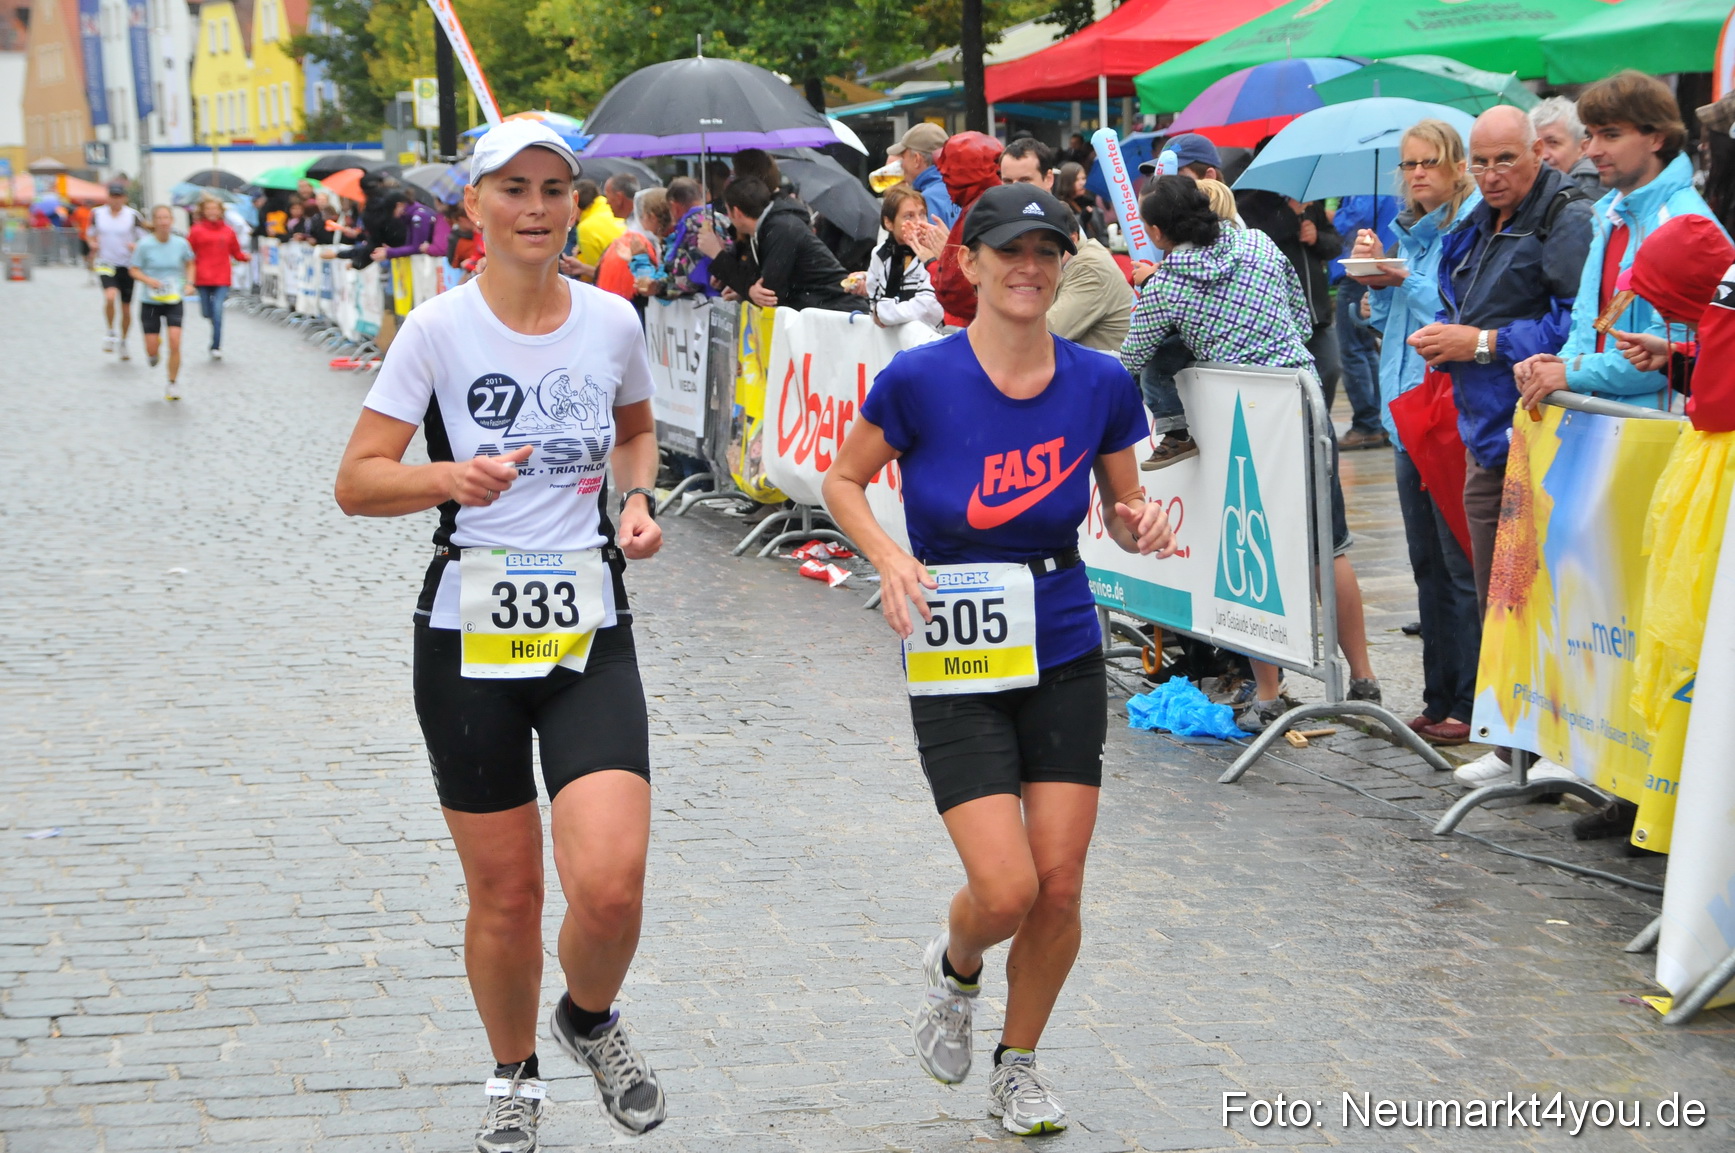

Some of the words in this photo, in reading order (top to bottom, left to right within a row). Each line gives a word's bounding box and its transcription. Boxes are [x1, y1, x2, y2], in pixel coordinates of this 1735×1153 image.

[1106, 137, 1139, 222] ReiseCenter
[1130, 224, 1147, 250] TUI
[473, 385, 516, 418] 27
[982, 436, 1065, 496] FAST
[506, 554, 563, 566] BOCK
[937, 571, 989, 586] BOCK
[491, 581, 580, 629] 333
[466, 623, 473, 632] C
[925, 597, 1008, 647] 505
[1269, 623, 1288, 646] GmbH
[511, 640, 559, 659] Heidi
[944, 656, 989, 675] Moni
